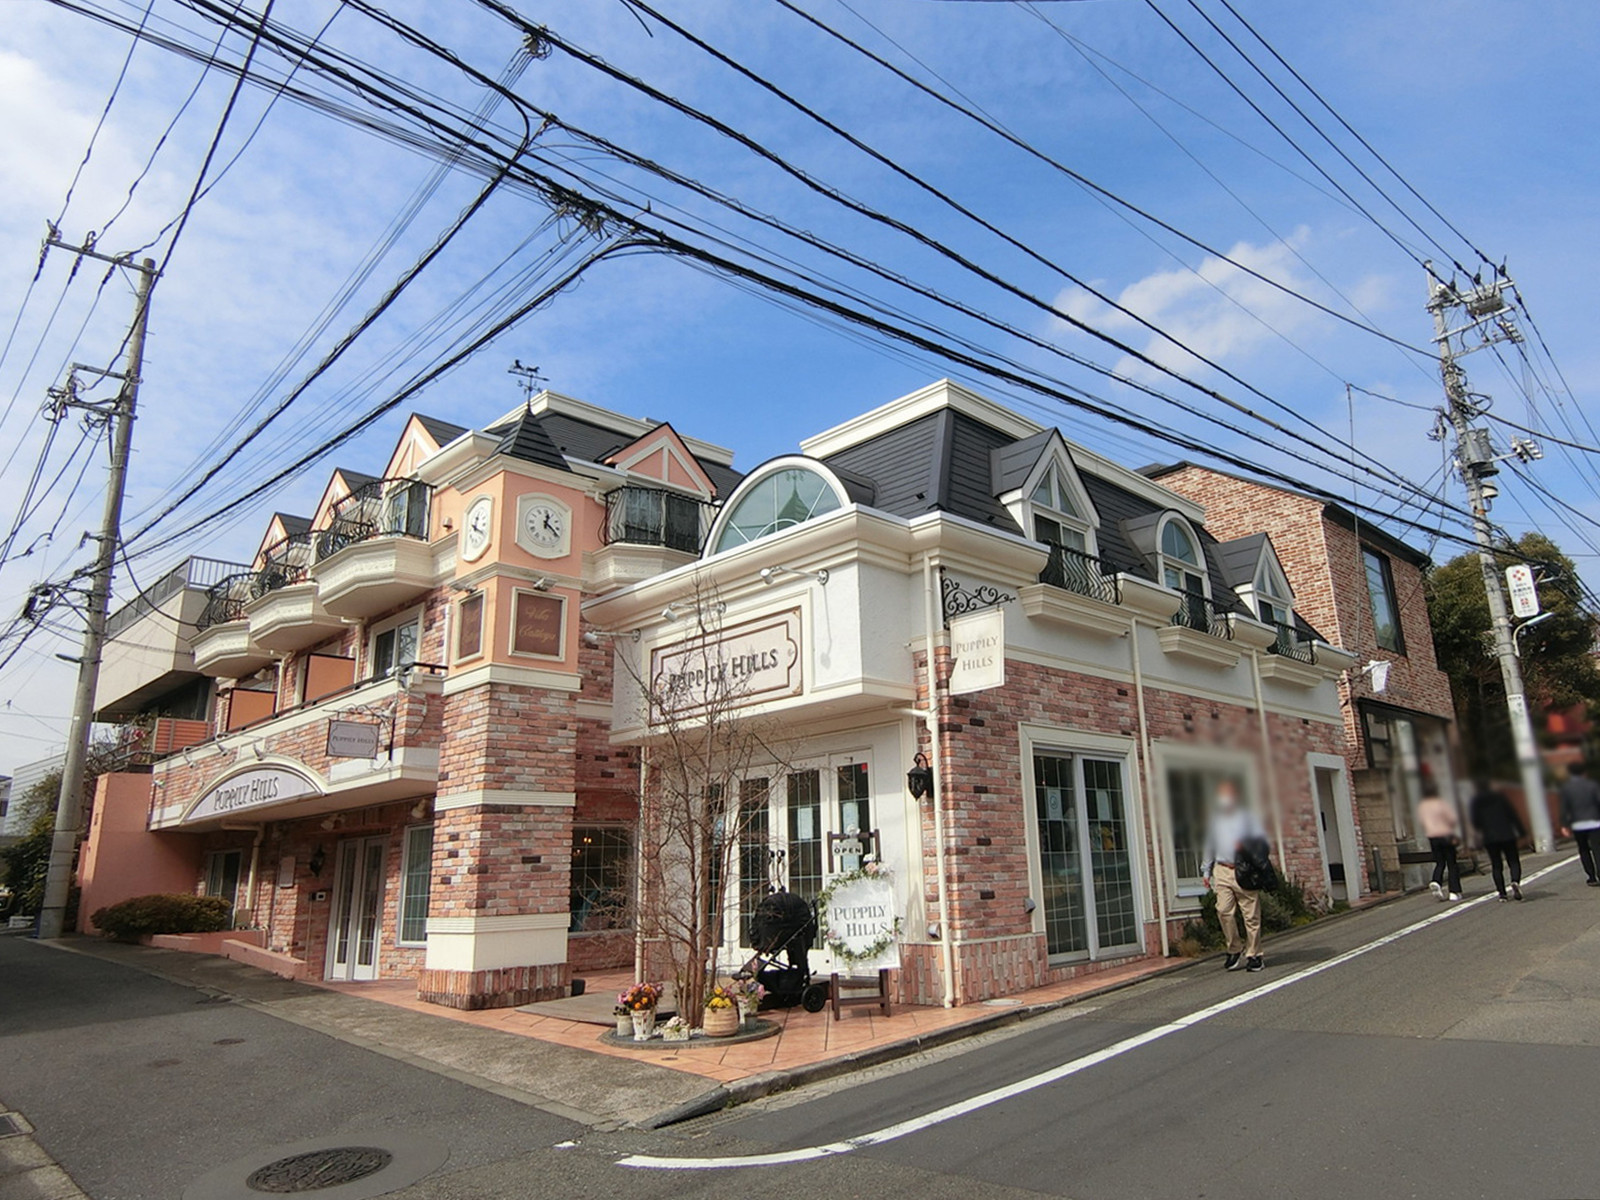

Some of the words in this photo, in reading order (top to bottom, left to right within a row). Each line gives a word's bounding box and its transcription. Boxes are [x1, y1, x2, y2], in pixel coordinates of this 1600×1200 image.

[956, 636, 999, 655] PUPPILY
[731, 648, 779, 679] HILLS
[962, 656, 993, 671] HILLS
[213, 784, 250, 811] PUPPILY
[250, 776, 279, 803] HILLS
[833, 846, 862, 854] OPEN
[833, 905, 887, 921] PUPPILY
[846, 921, 889, 938] HILLS
